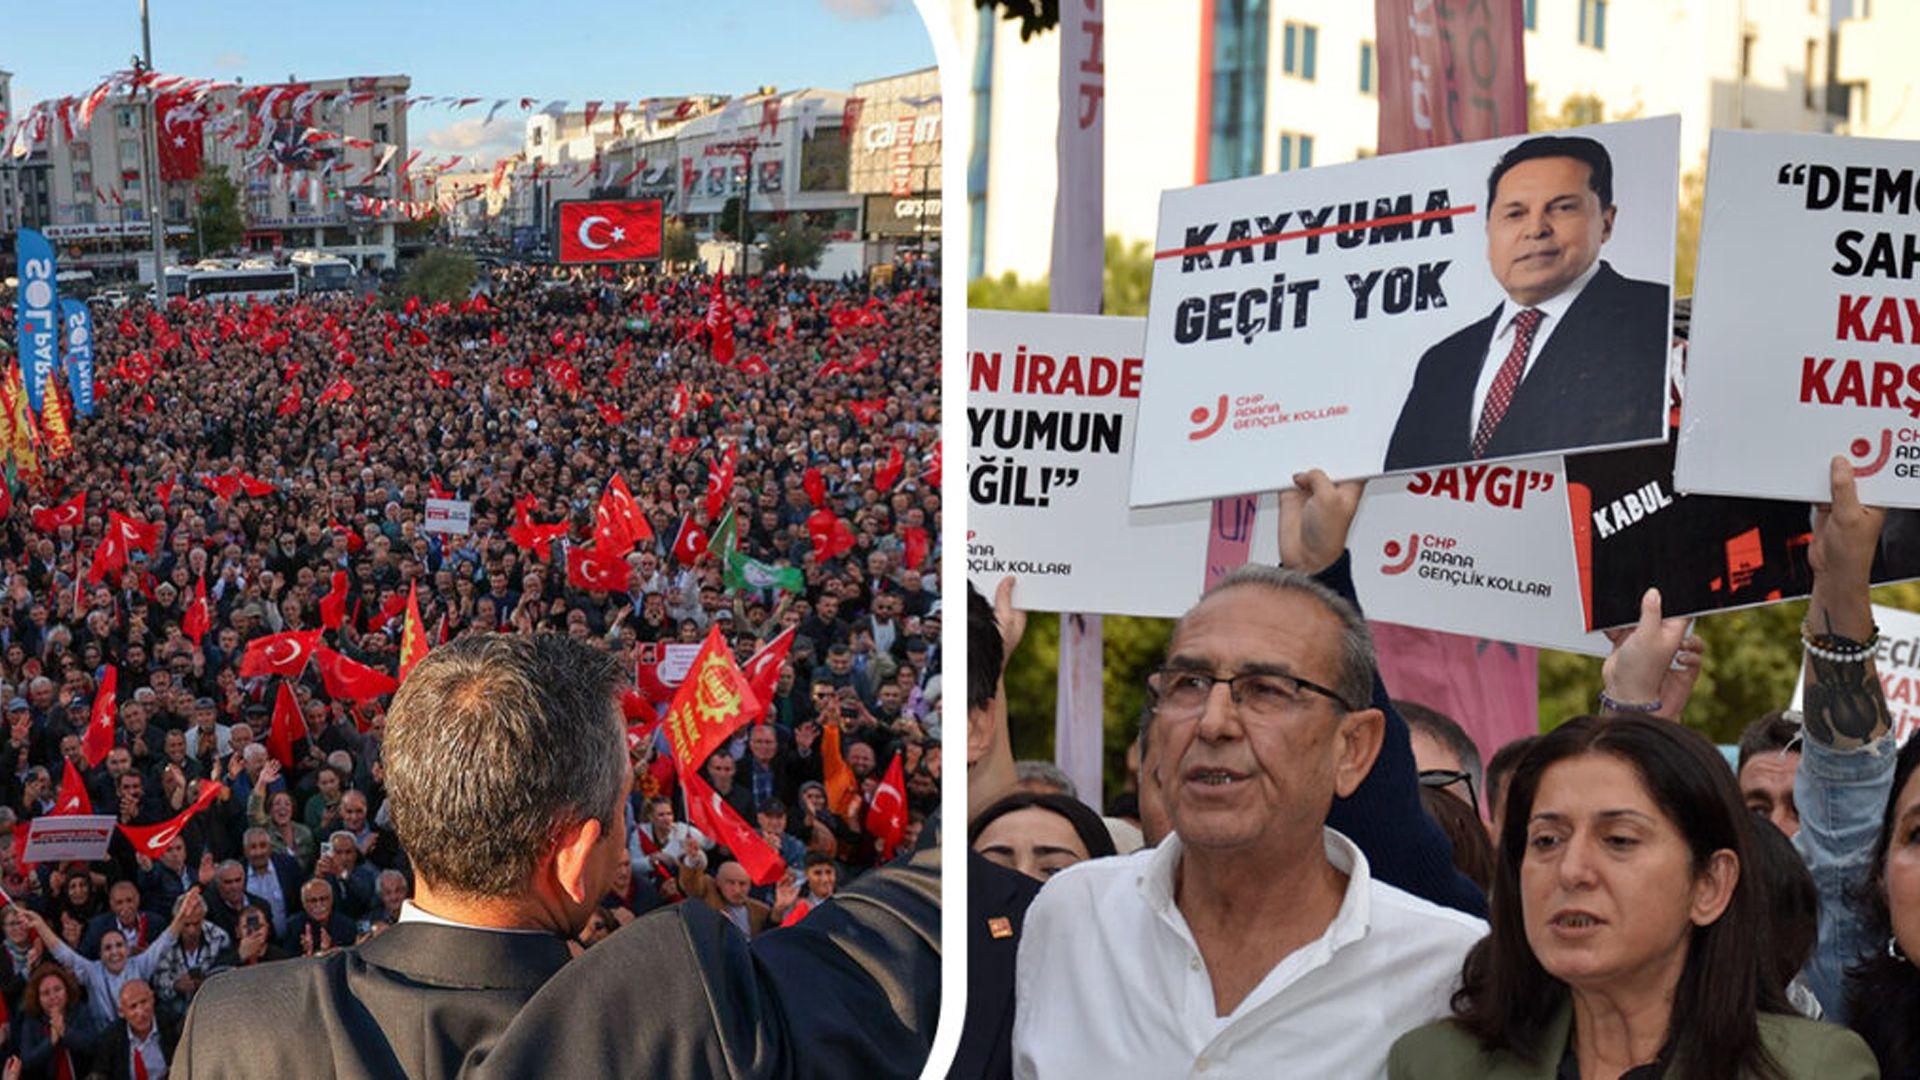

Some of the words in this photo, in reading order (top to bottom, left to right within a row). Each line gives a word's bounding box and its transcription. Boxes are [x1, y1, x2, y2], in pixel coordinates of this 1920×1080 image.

[1777, 163, 1920, 215] “DEM
[1181, 189, 1454, 273] KAYYUMA
[1174, 273, 1320, 344] GEÇİT
[1345, 260, 1453, 320] YOK
[967, 351, 1002, 393] N
[1013, 345, 1144, 398] İRADE
[1234, 403, 1281, 418] ADANA
[1235, 393, 1265, 407] CHP
[967, 407, 1123, 454] YUMUN
[1232, 413, 1291, 431] GENÇLİK
[1293, 405, 1349, 422] KOLLARI
[967, 455, 1080, 507] ĞİL!”
[1894, 463, 1920, 478] GE
[1592, 480, 1673, 539] KABUL
[1423, 534, 1457, 550] CHP
[1008, 561, 1072, 575] KOLLARI
[1420, 550, 1474, 569] ADANA
[1418, 565, 1485, 587] GENÇLİK
[1487, 575, 1552, 597] KOLLARI
[1875, 635, 1920, 668] EÇİ
